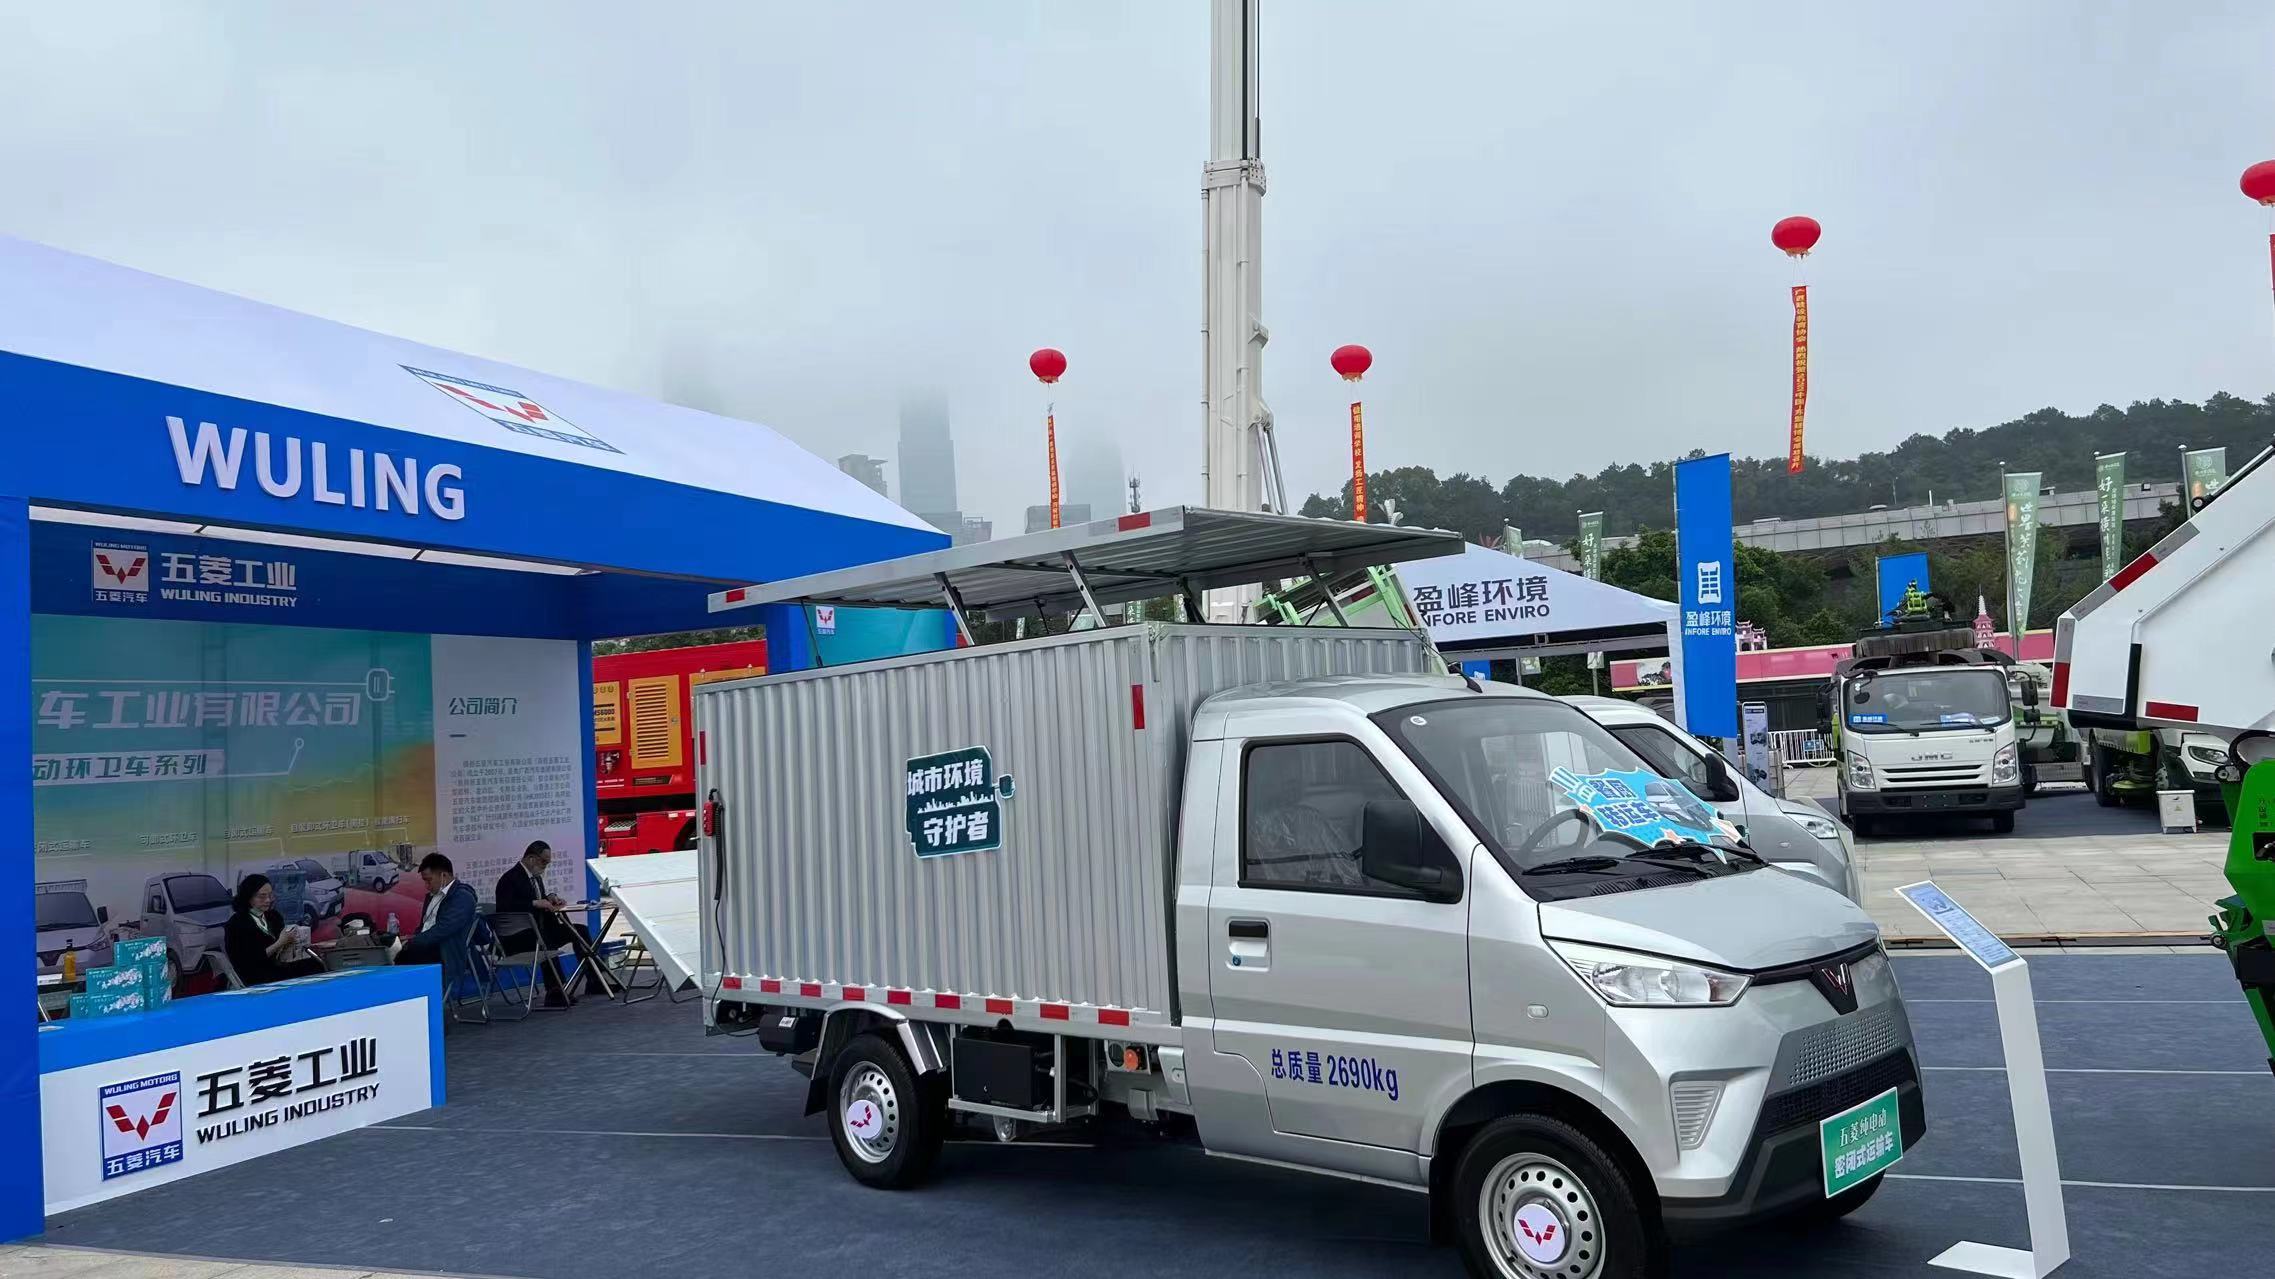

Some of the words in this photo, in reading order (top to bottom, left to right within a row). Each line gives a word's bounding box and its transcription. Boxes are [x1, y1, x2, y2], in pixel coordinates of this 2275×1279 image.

[165, 415, 466, 520] WULING
[160, 552, 297, 591] 五菱工业
[95, 590, 148, 604] 五菱汽车
[160, 588, 222, 603] WULING
[224, 593, 298, 608] INDUSTRY
[1413, 575, 1549, 613] 盈峰环境
[1485, 604, 1550, 622] ENVIRO
[1686, 610, 1731, 627] 盈峰环境
[448, 697, 519, 716] 公司简介
[1911, 751, 1953, 762] JMC
[907, 758, 984, 796] 城市环境
[923, 811, 989, 847] 守护者
[103, 1081, 140, 1095] WULING
[139, 1073, 178, 1088] MOTORS
[196, 1037, 379, 1118] 五菱工业
[1271, 1048, 1324, 1085] 总质量
[1326, 1054, 1400, 1101] 2690kg
[196, 1109, 279, 1145] WULING
[283, 1083, 381, 1123] INDUSTRY
[1839, 1108, 1888, 1148] 五菱纯电动
[106, 1143, 180, 1177] 五菱汽车
